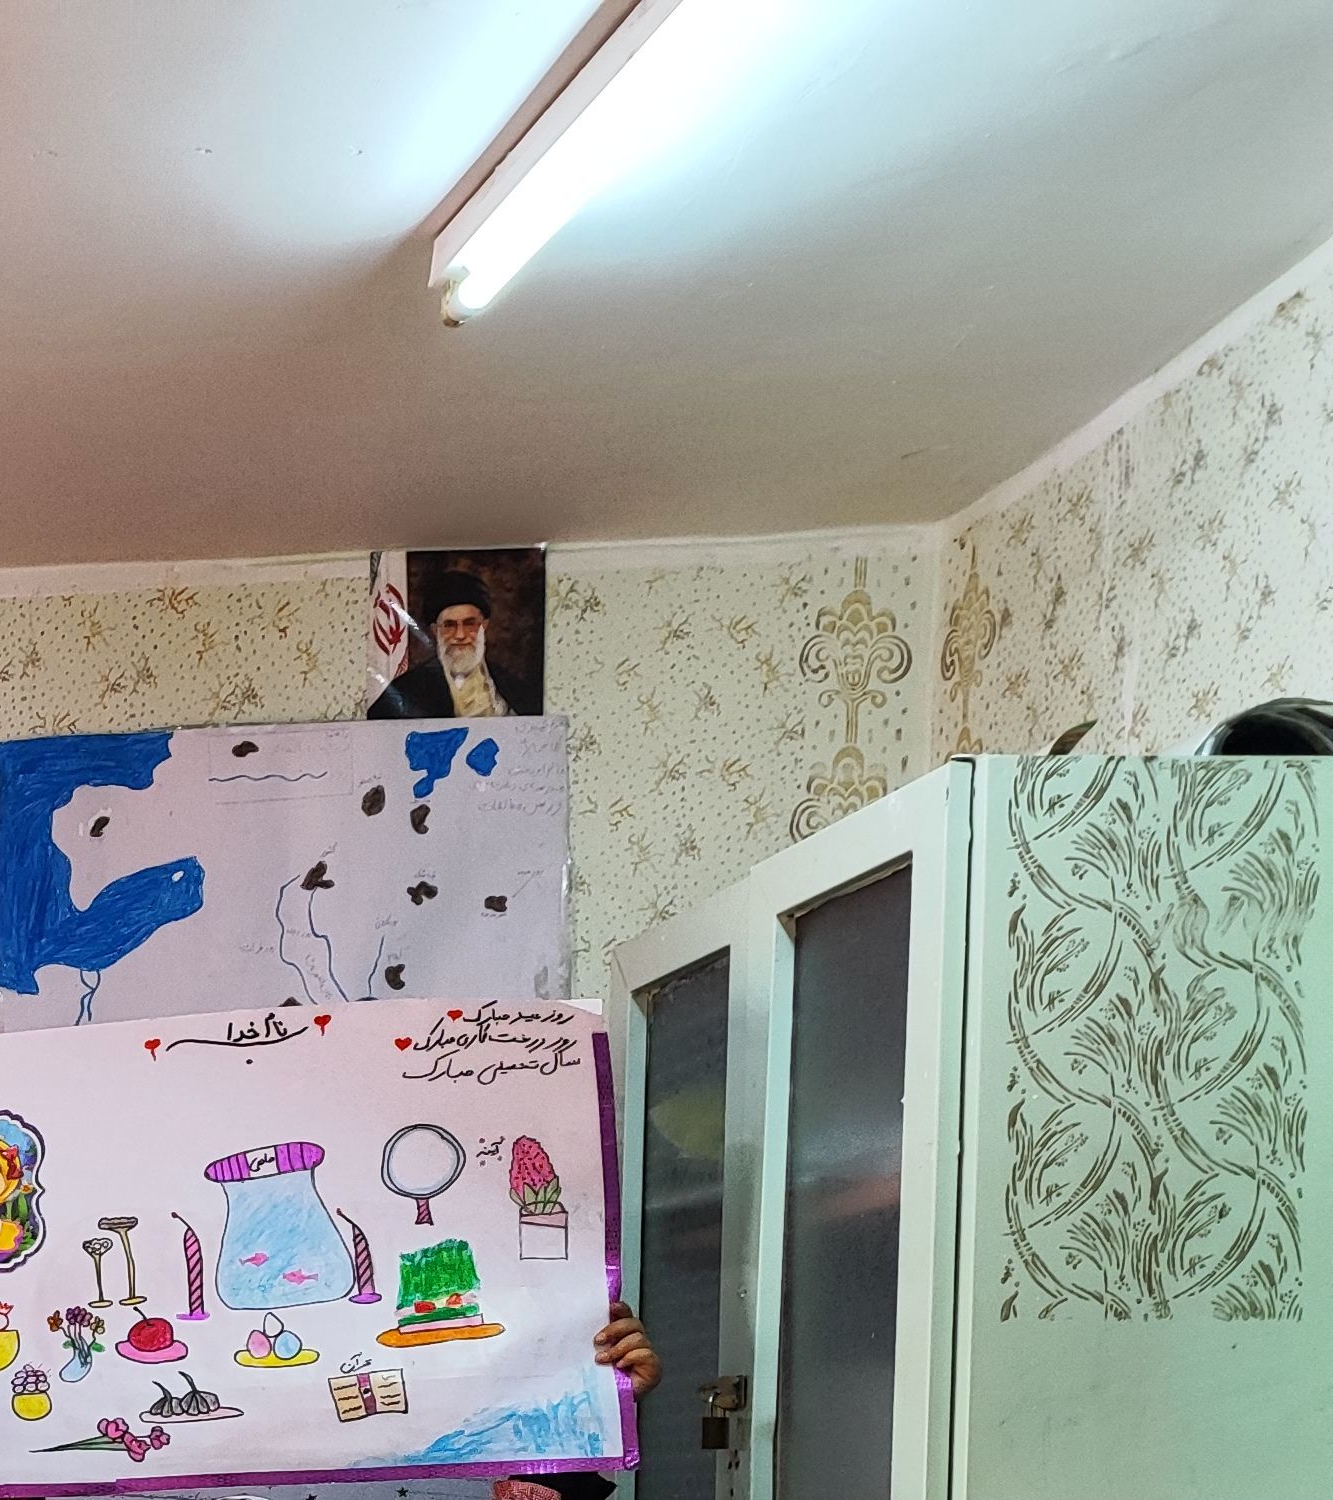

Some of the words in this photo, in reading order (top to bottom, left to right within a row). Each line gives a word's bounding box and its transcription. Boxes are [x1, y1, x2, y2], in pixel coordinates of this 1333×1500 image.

[462, 999, 511, 1026] مبارک
[508, 1010, 542, 1026] عید
[540, 1009, 575, 1026] روز
[227, 1022, 261, 1043] خدا
[412, 1016, 456, 1053] مبارک
[543, 1036, 578, 1053] روز
[401, 1048, 475, 1084] مبارک
[476, 1059, 540, 1086] تحصیلی
